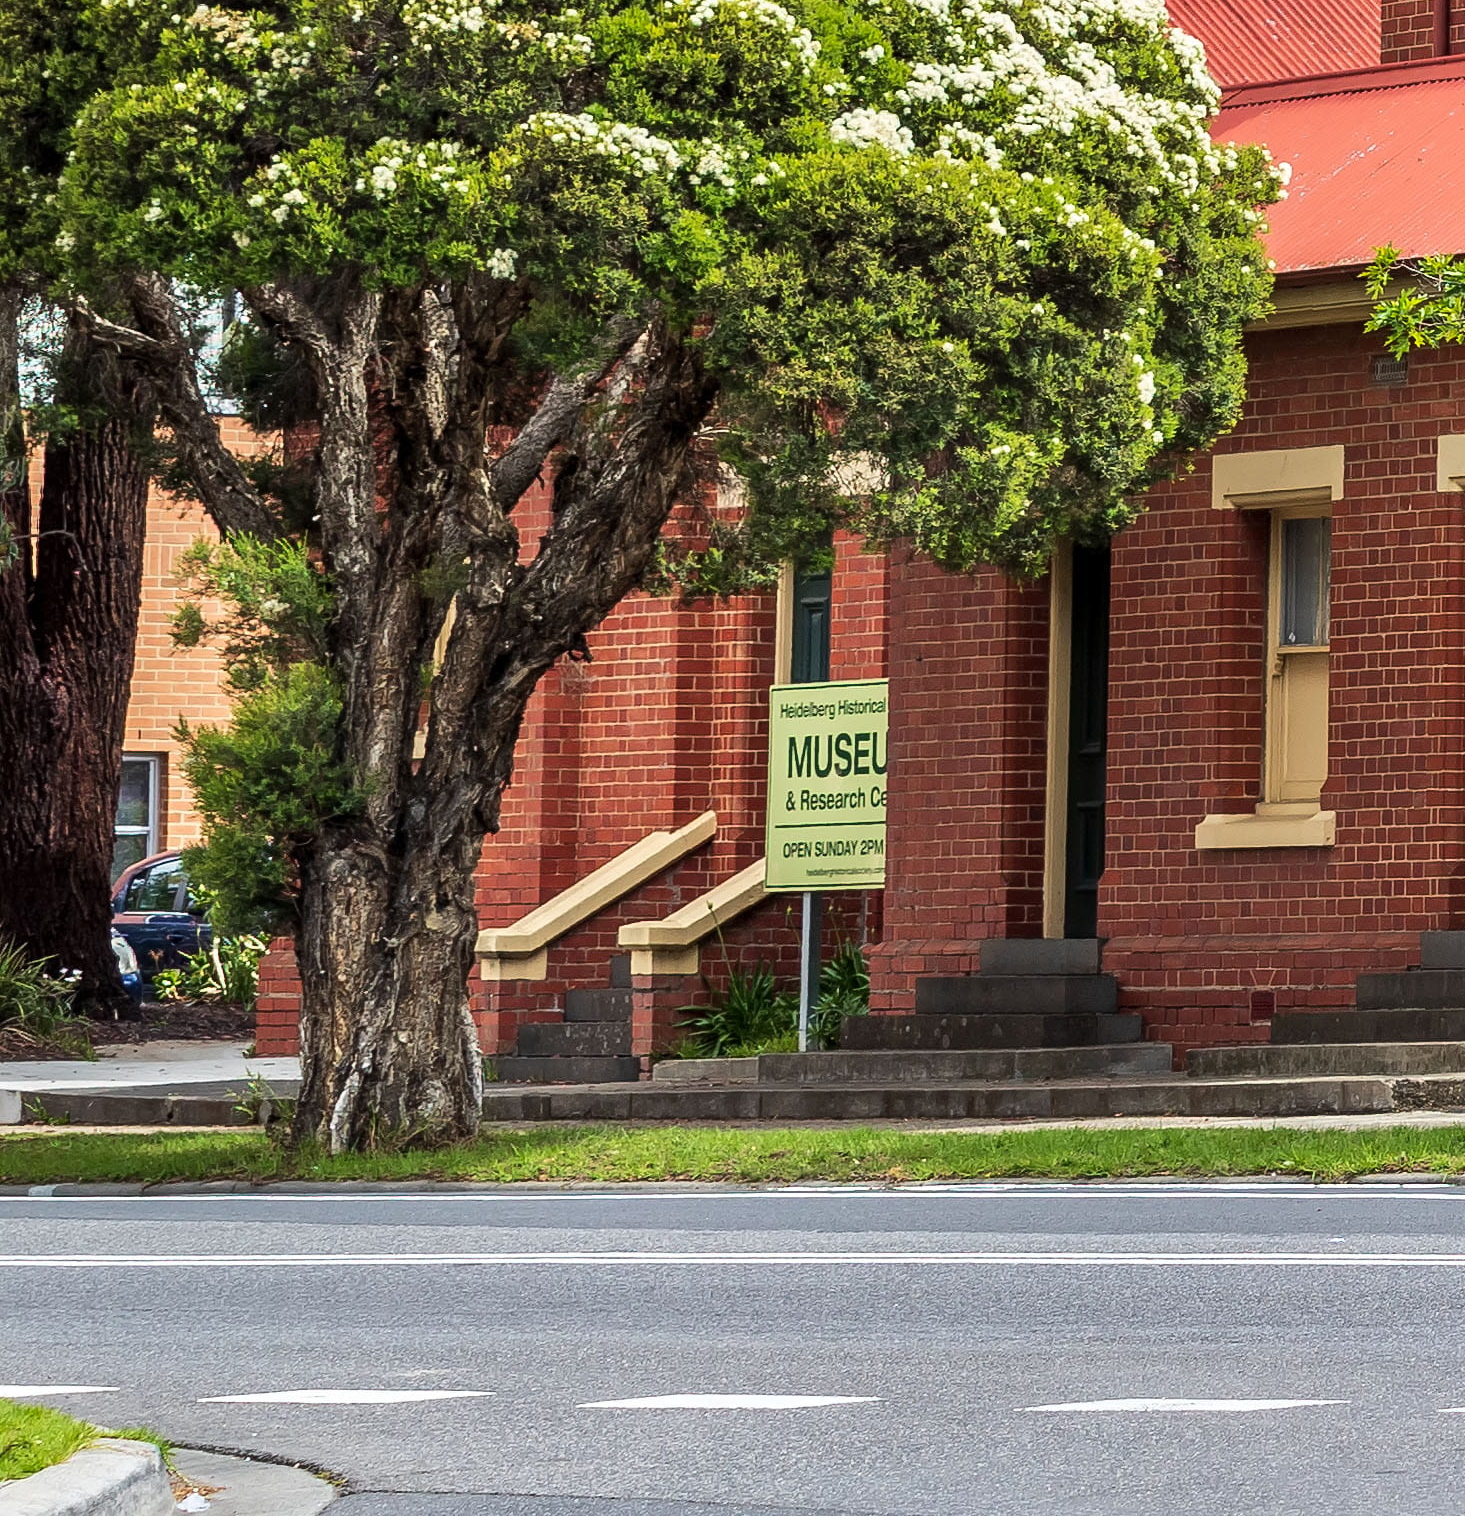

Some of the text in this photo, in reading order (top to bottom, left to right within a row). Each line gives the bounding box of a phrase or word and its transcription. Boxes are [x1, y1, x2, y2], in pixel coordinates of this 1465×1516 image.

[780, 697, 886, 720] Heidelberg Historical
[785, 790, 796, 811] &
[800, 787, 866, 811] Research
[783, 838, 884, 858] OPEN SUNDAY 2PM
